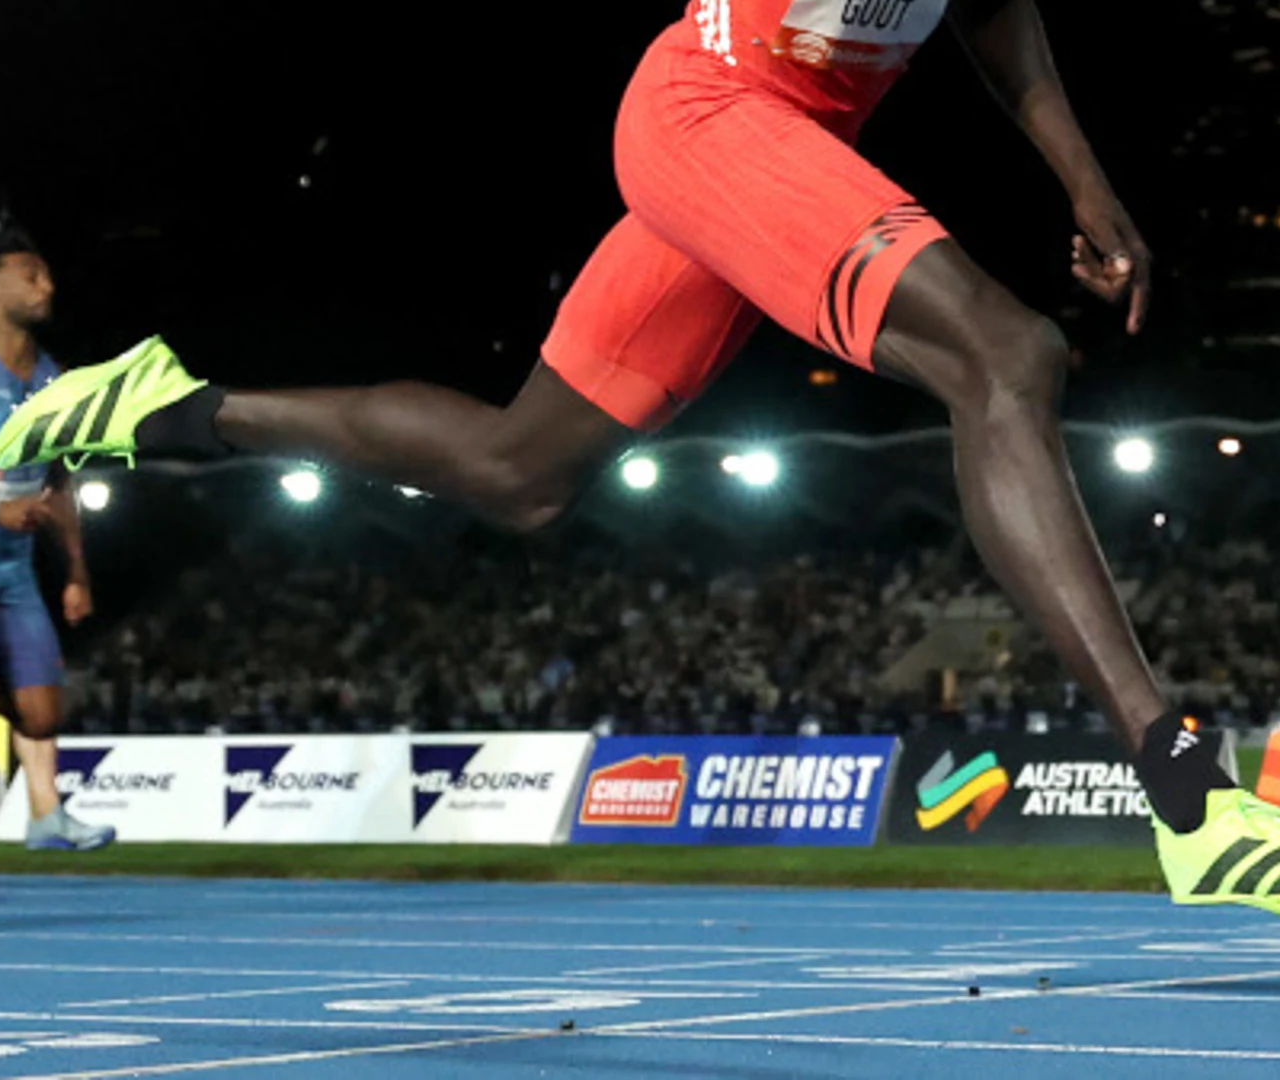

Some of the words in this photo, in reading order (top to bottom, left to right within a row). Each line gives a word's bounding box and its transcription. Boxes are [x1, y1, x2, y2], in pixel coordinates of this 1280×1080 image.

[696, 754, 883, 800] CHEMIST
[1014, 762, 1142, 789] AUSTRAL
[592, 779, 678, 801] CHEMIST
[1021, 789, 1152, 816] ATHLETIC
[690, 804, 865, 829] WAREHOUSE
